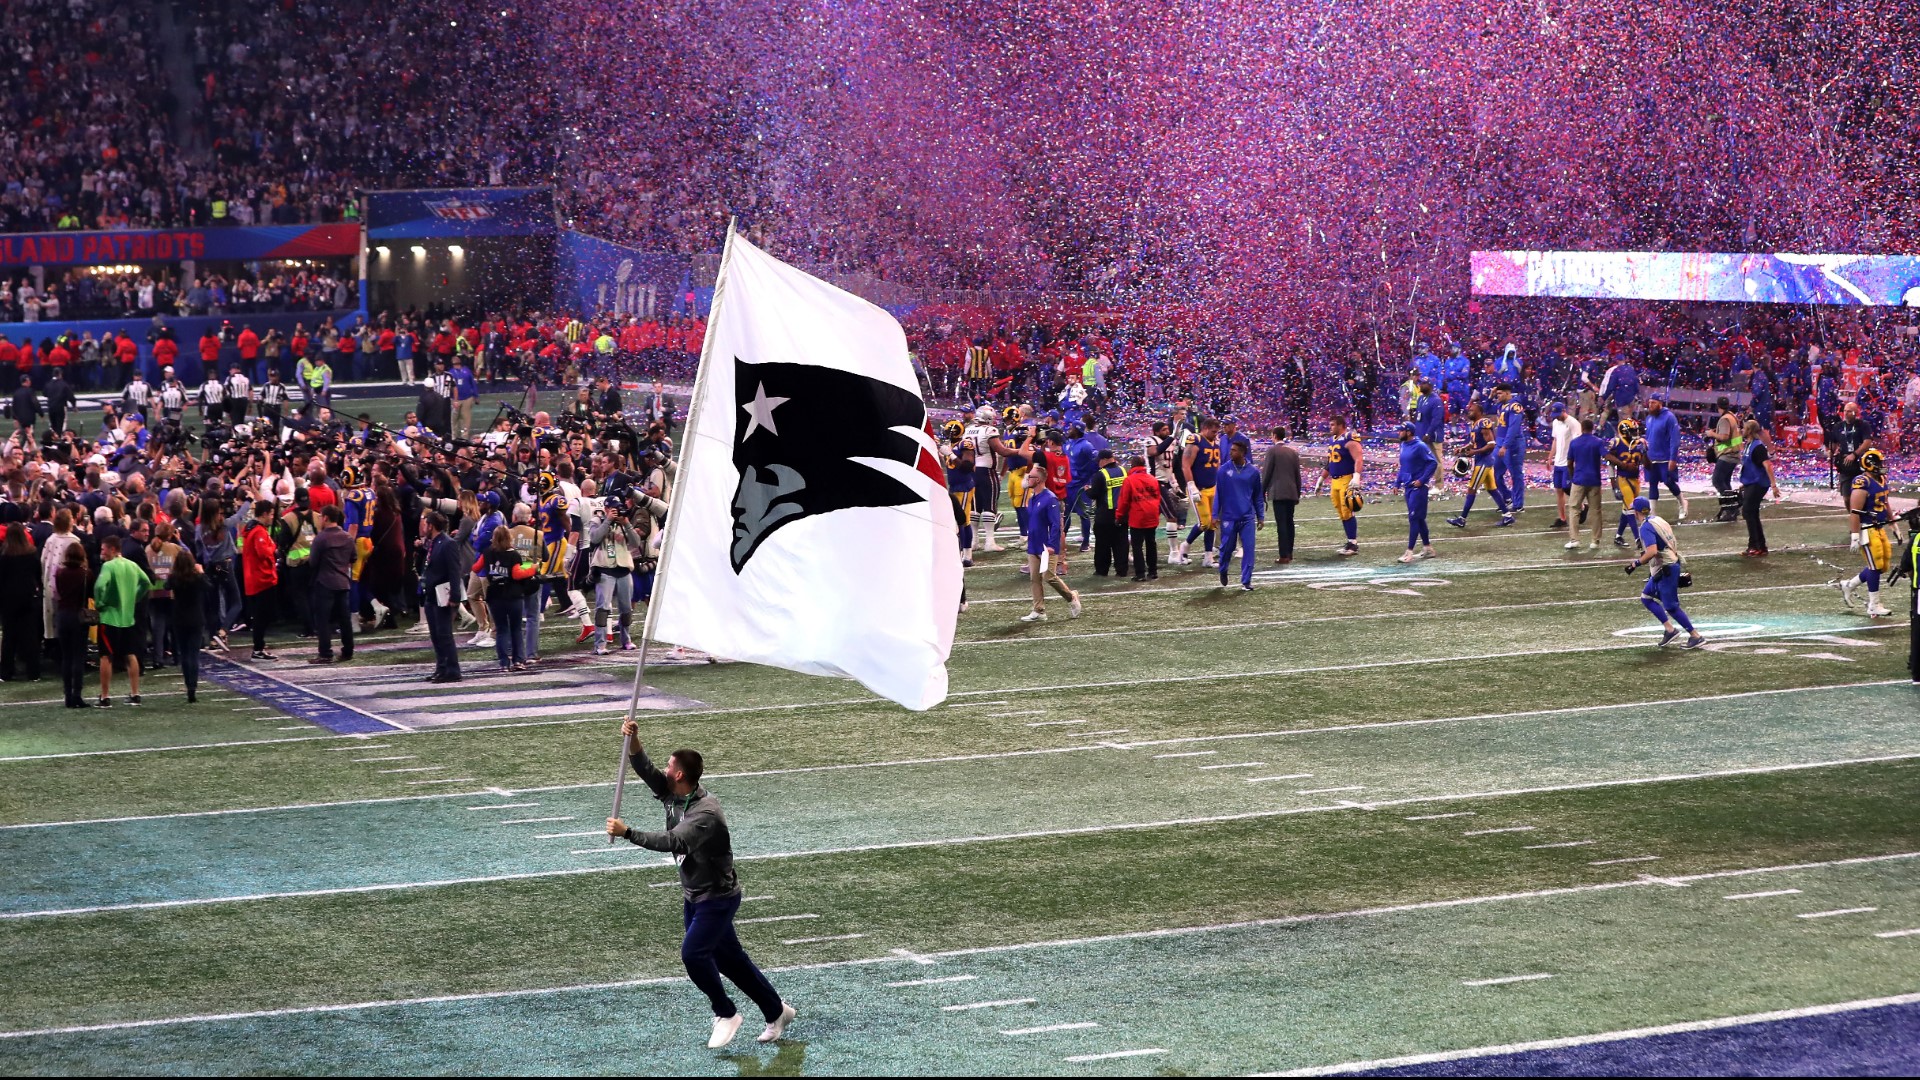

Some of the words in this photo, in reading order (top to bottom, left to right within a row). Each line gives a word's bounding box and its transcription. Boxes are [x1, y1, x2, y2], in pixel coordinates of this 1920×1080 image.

[436, 207, 493, 220] NFL
[81, 232, 205, 262] PATRIOTS
[1203, 447, 1221, 468] 79
